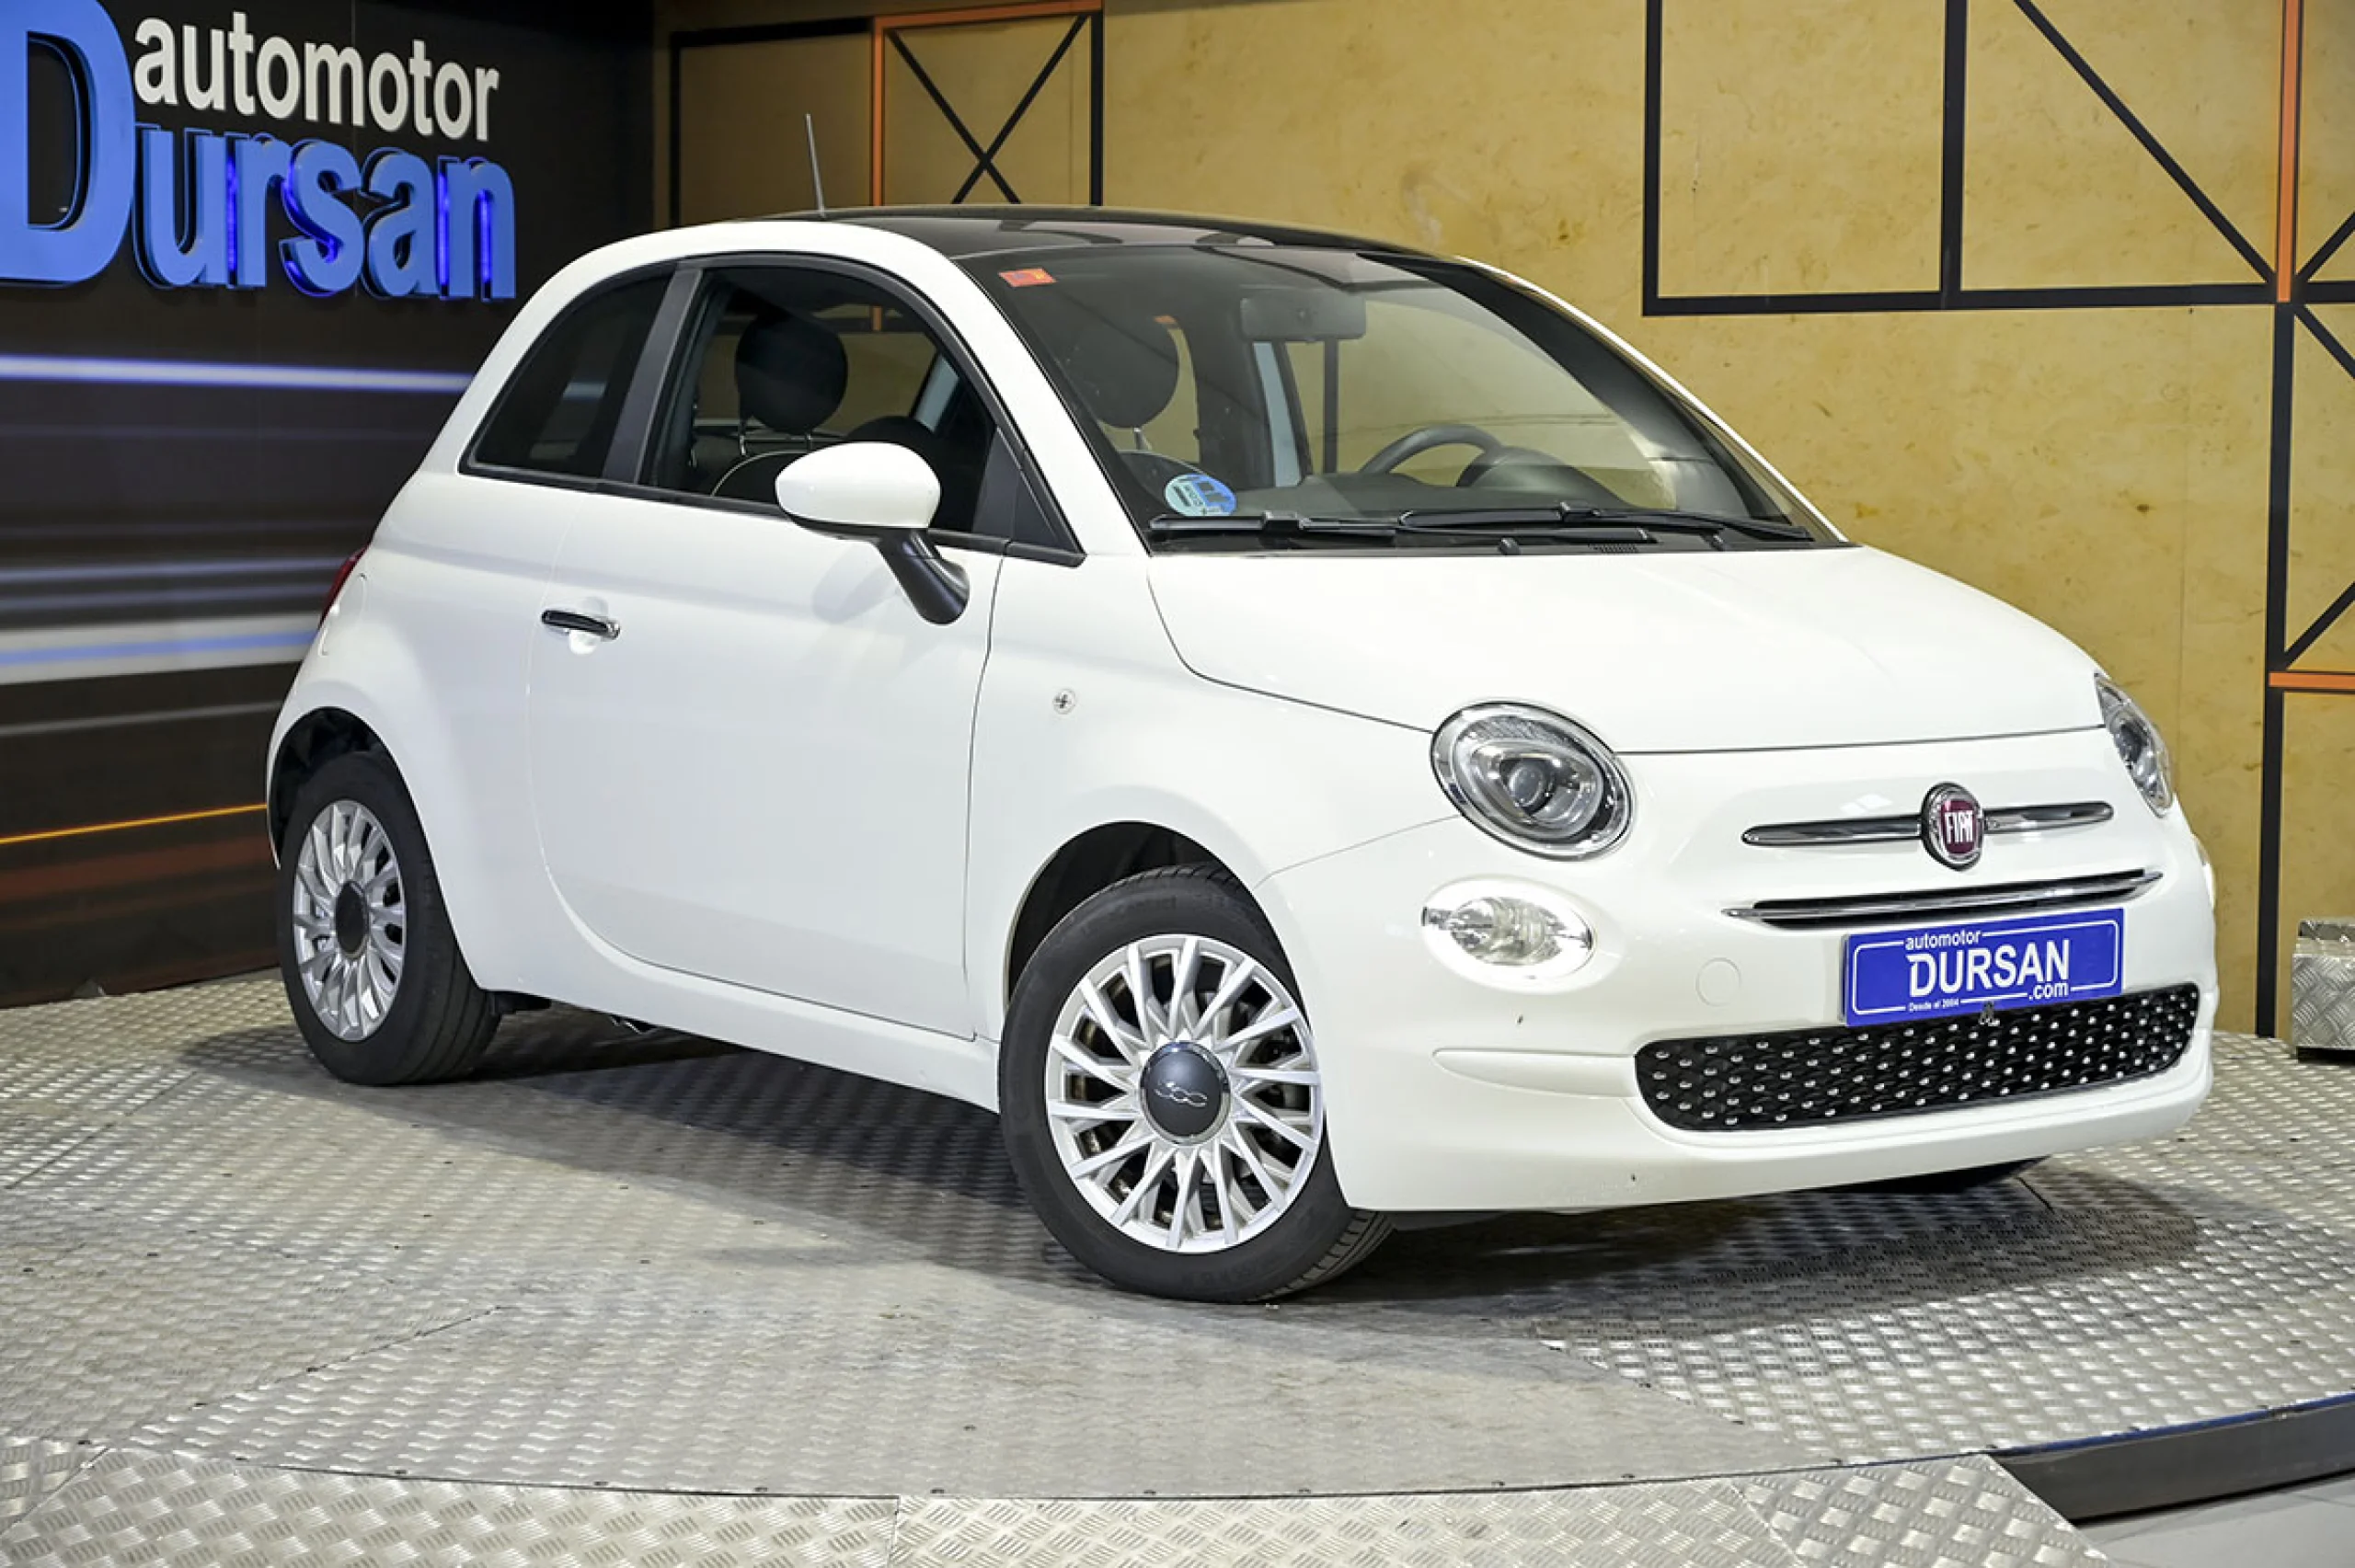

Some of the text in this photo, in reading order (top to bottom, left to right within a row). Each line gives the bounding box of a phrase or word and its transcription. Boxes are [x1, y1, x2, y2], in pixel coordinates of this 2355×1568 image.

[134, 11, 500, 142] automotor
[0, 0, 516, 301] Dursan
[1944, 809, 1974, 844] FIAT
[1906, 930, 1982, 950] automotor
[1906, 938, 2070, 997] DURSAN
